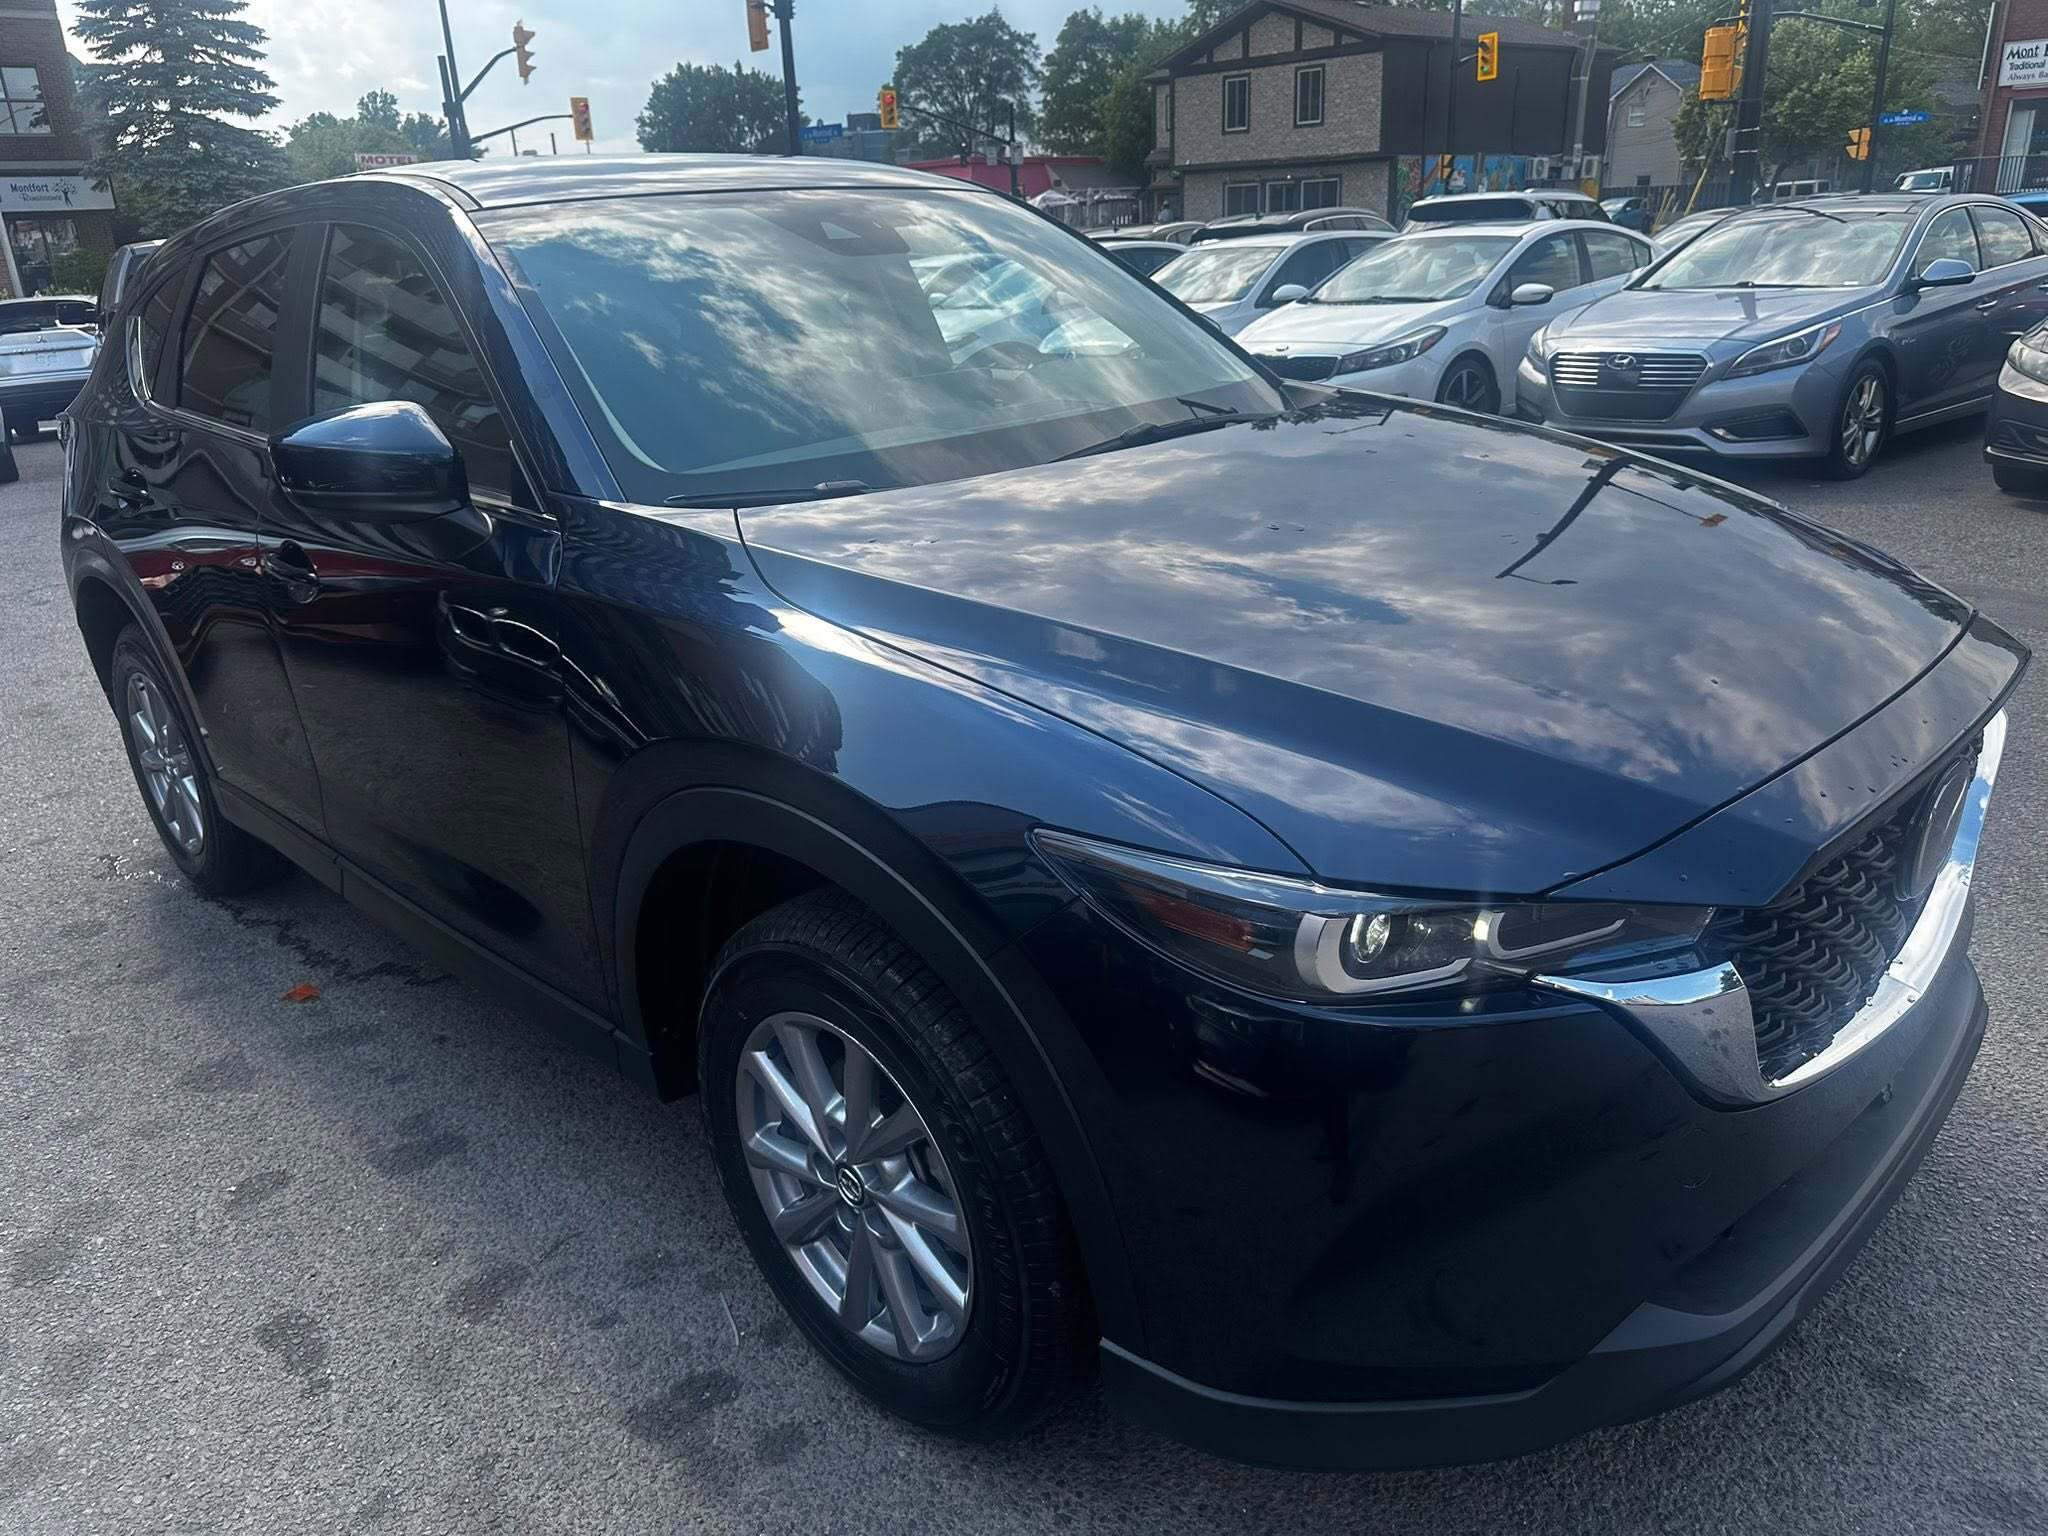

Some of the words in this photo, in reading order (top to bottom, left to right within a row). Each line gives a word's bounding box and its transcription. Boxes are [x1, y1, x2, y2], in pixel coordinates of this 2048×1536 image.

[2006, 46, 2040, 60] Mont
[2009, 60, 2046, 70] Traditional
[360, 155, 417, 164] MOTEL
[10, 183, 49, 193] Montfort
